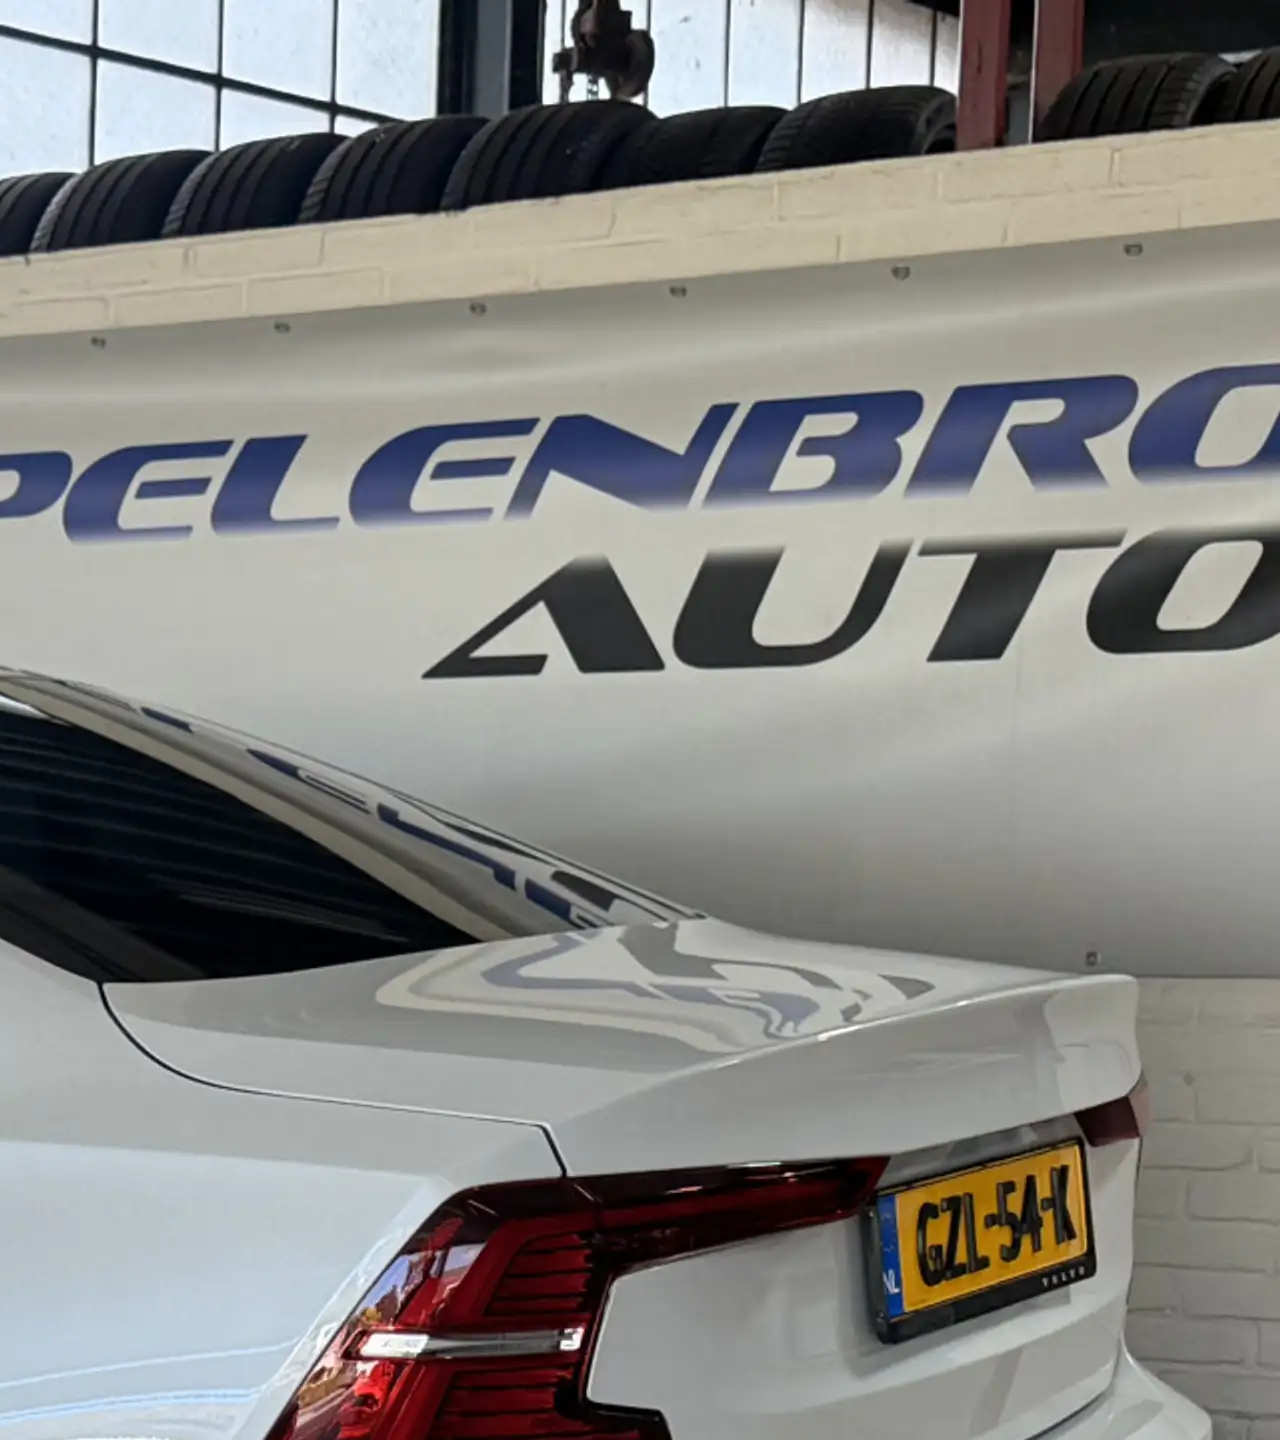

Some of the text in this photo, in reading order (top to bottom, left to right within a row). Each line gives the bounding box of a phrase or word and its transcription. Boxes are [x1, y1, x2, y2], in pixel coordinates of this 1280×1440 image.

[421, 522, 1280, 679] AUTO
[883, 1269, 900, 1294] NL
[916, 1164, 1077, 1287] GZL-54-K
